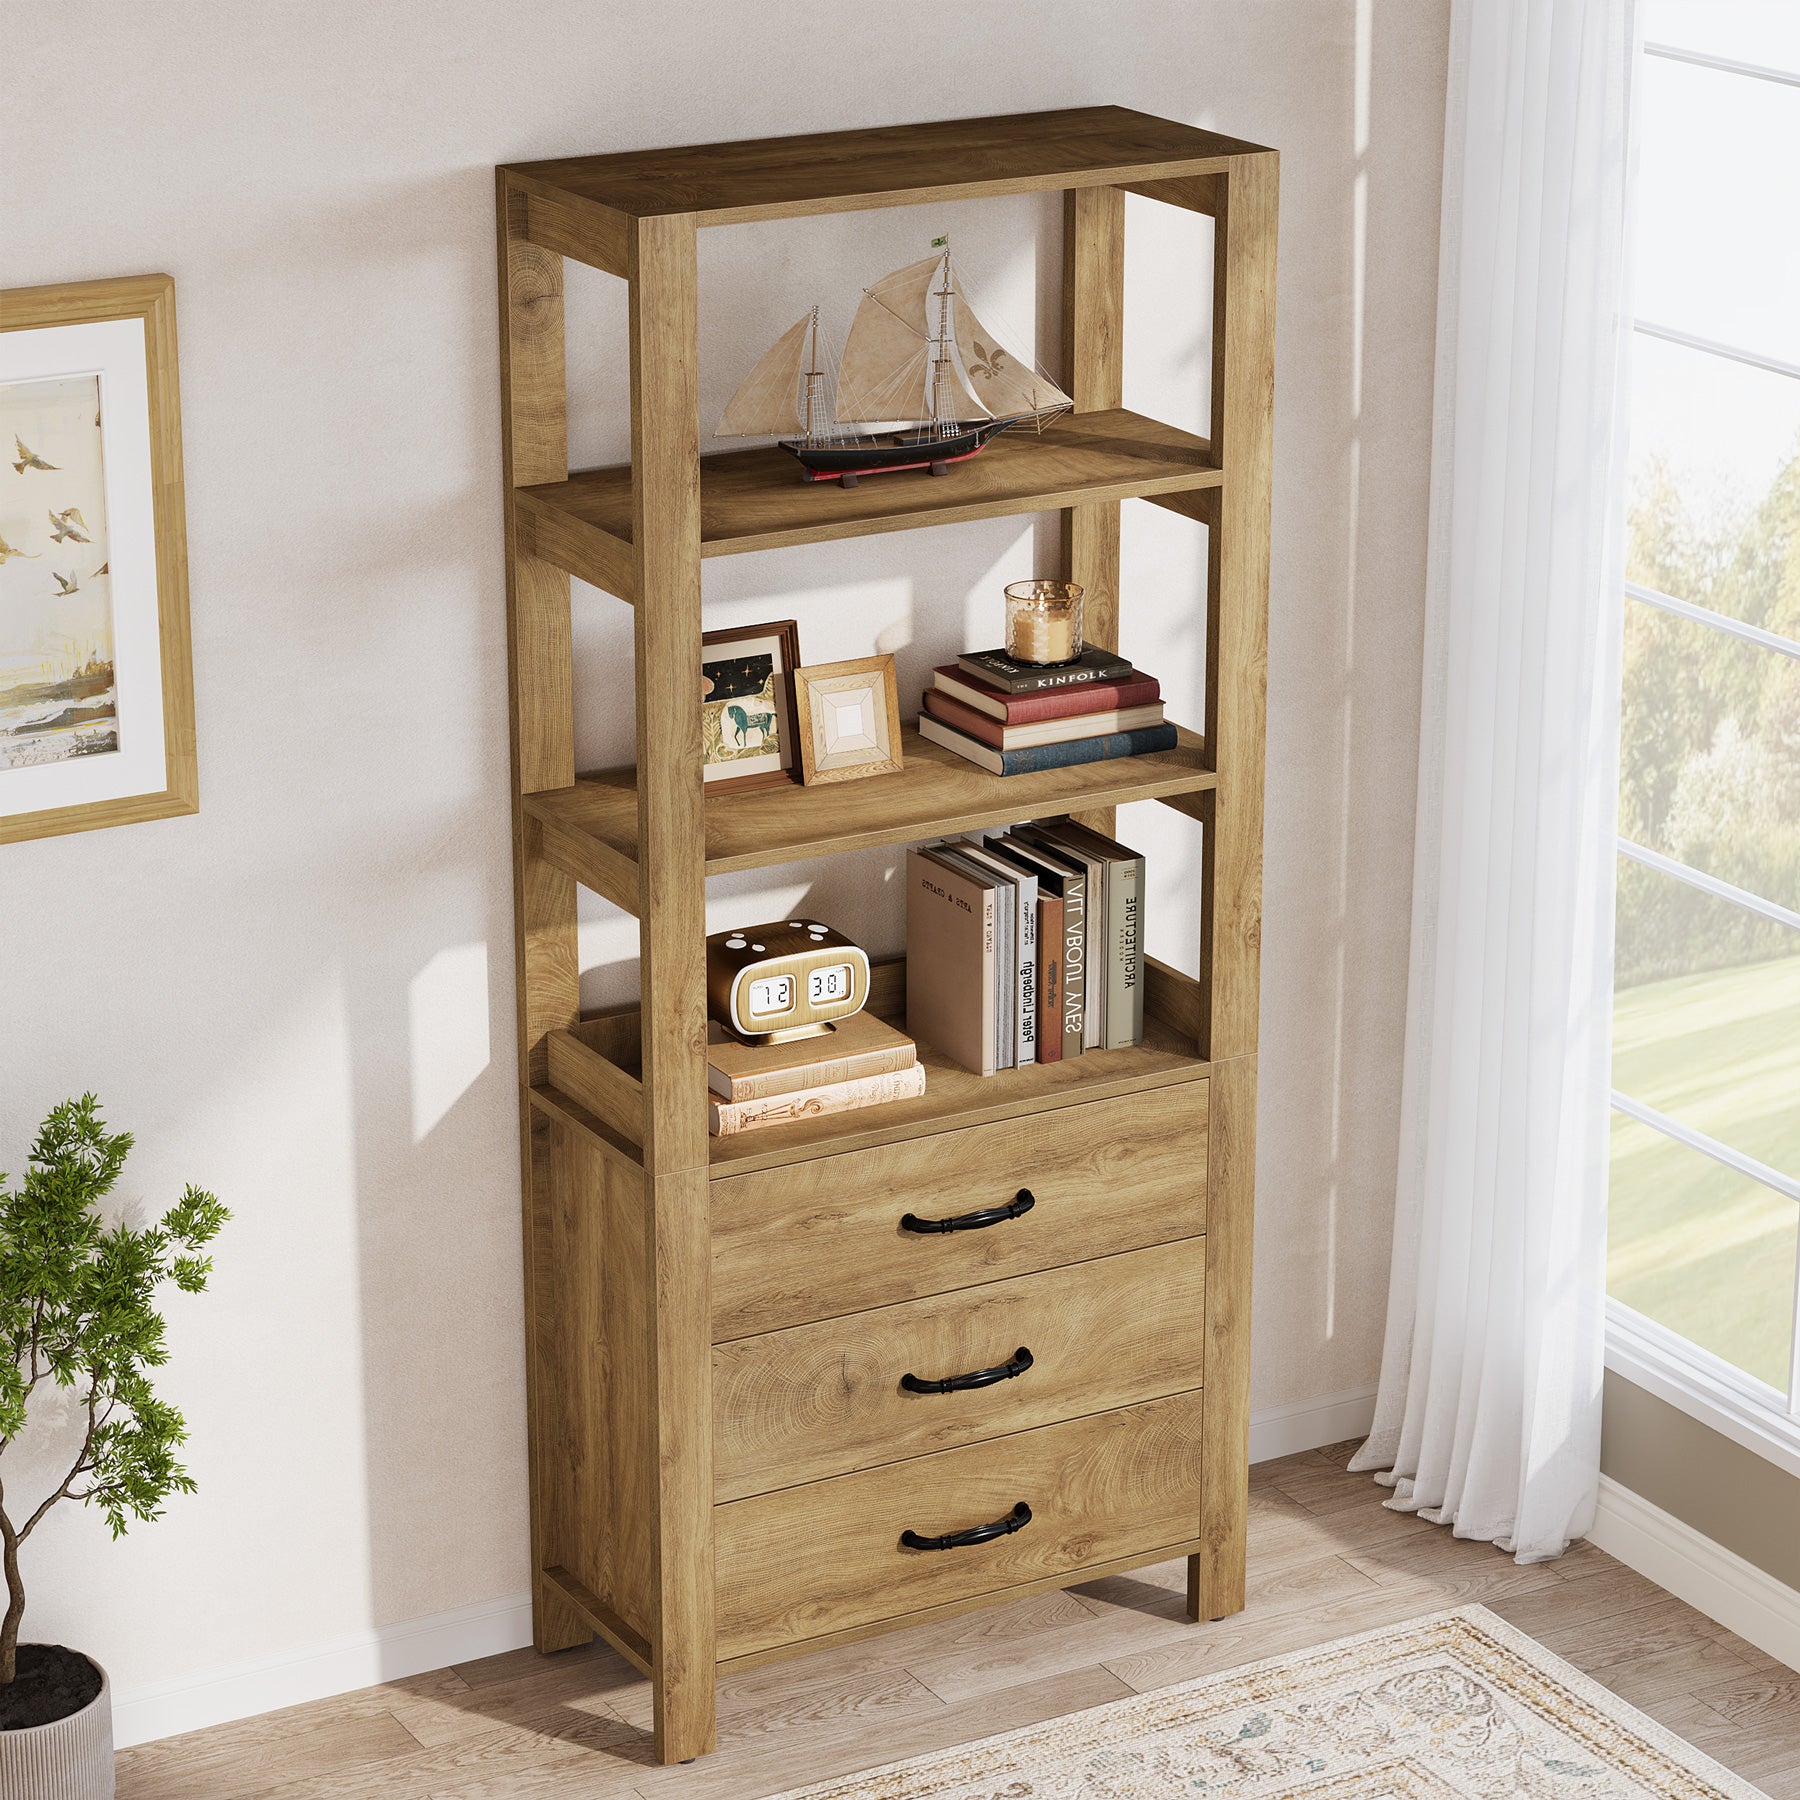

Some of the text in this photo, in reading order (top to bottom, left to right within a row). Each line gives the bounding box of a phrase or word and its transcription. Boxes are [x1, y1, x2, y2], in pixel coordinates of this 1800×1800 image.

[1037, 669, 1108, 688] KINFOLK
[765, 974, 836, 1005] 12 30
